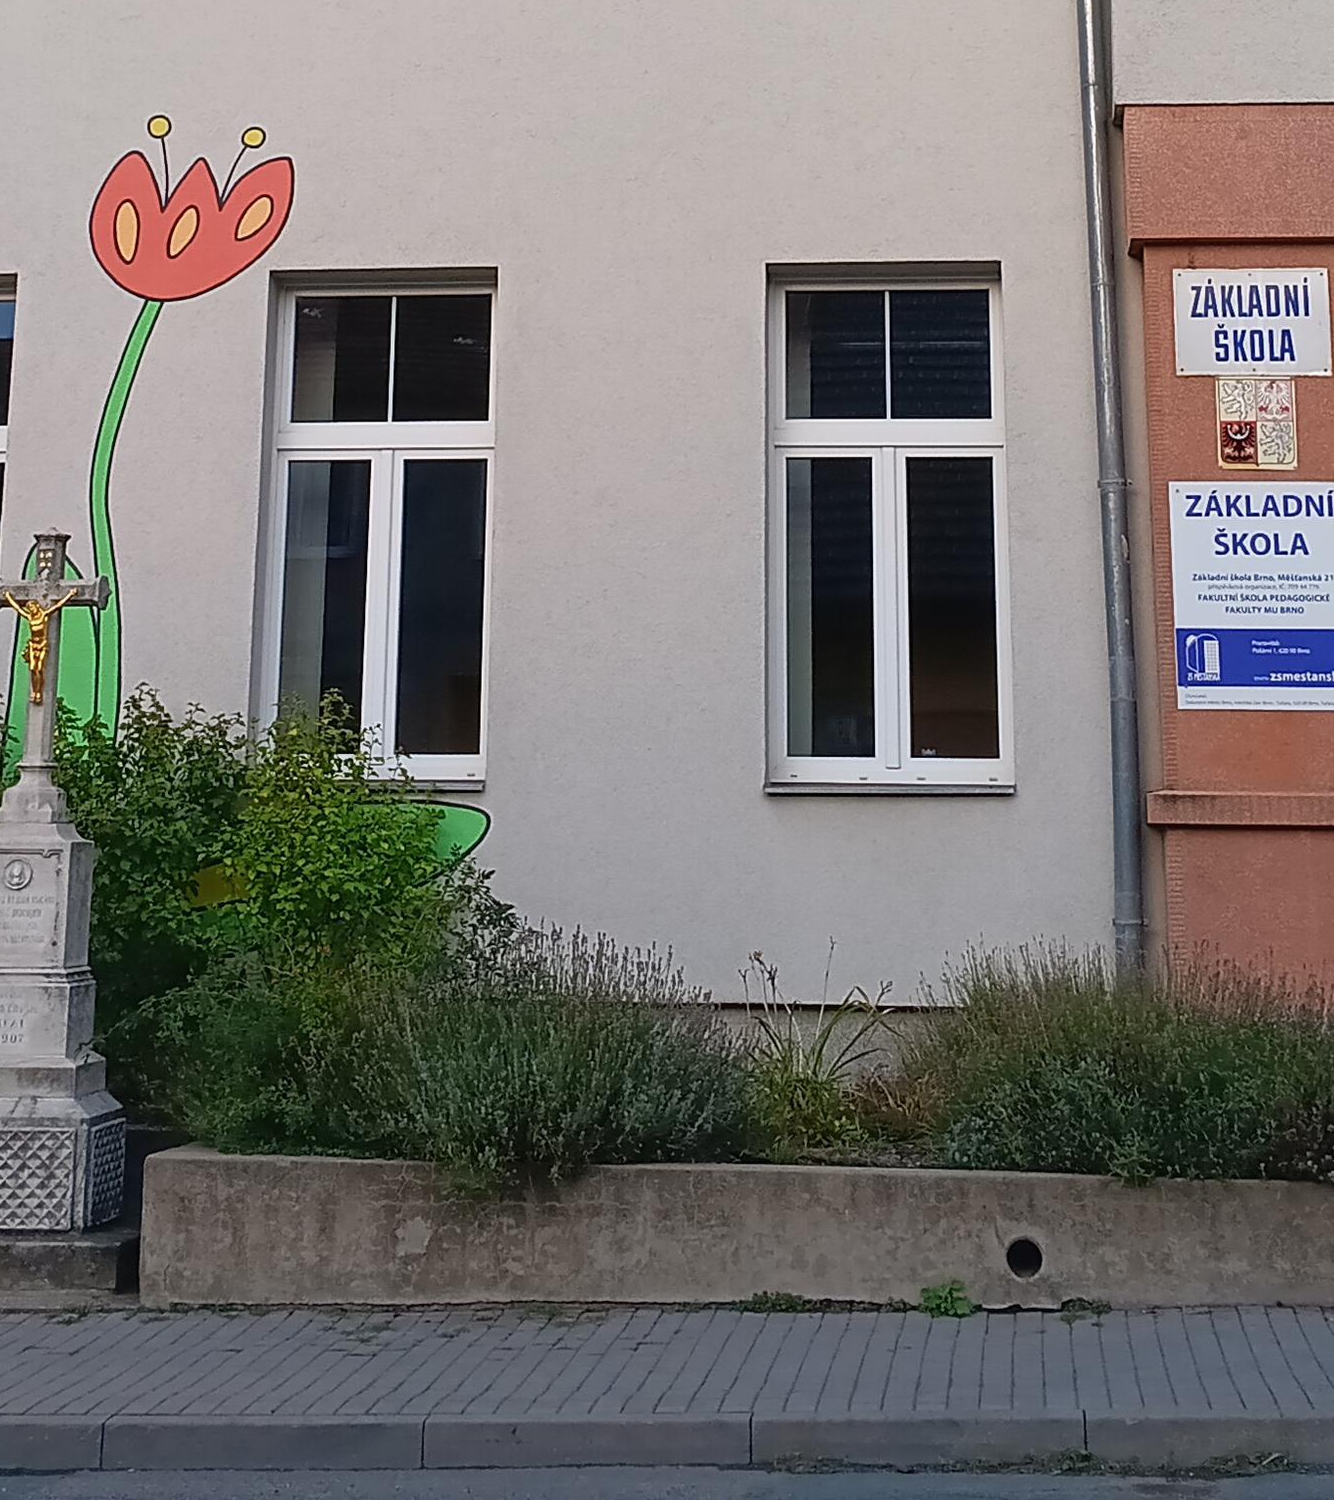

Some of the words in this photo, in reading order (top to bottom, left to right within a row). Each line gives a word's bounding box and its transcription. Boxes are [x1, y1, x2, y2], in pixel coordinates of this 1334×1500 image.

[1190, 277, 1310, 318] ZÁKLADNÍ
[1214, 323, 1296, 362] ŠKOLA
[1185, 490, 1334, 518] ZÁKLADNÍ
[1214, 528, 1310, 556] ŠKOLA
[1198, 593, 1238, 602] FAKULTNÍ
[1240, 593, 1269, 602] ŠKOLA
[1270, 593, 1330, 603] PEDAGOGICKÉ
[1225, 606, 1262, 614] FAKULTY
[1264, 606, 1278, 614] MU
[1280, 606, 1305, 614] BRNO
